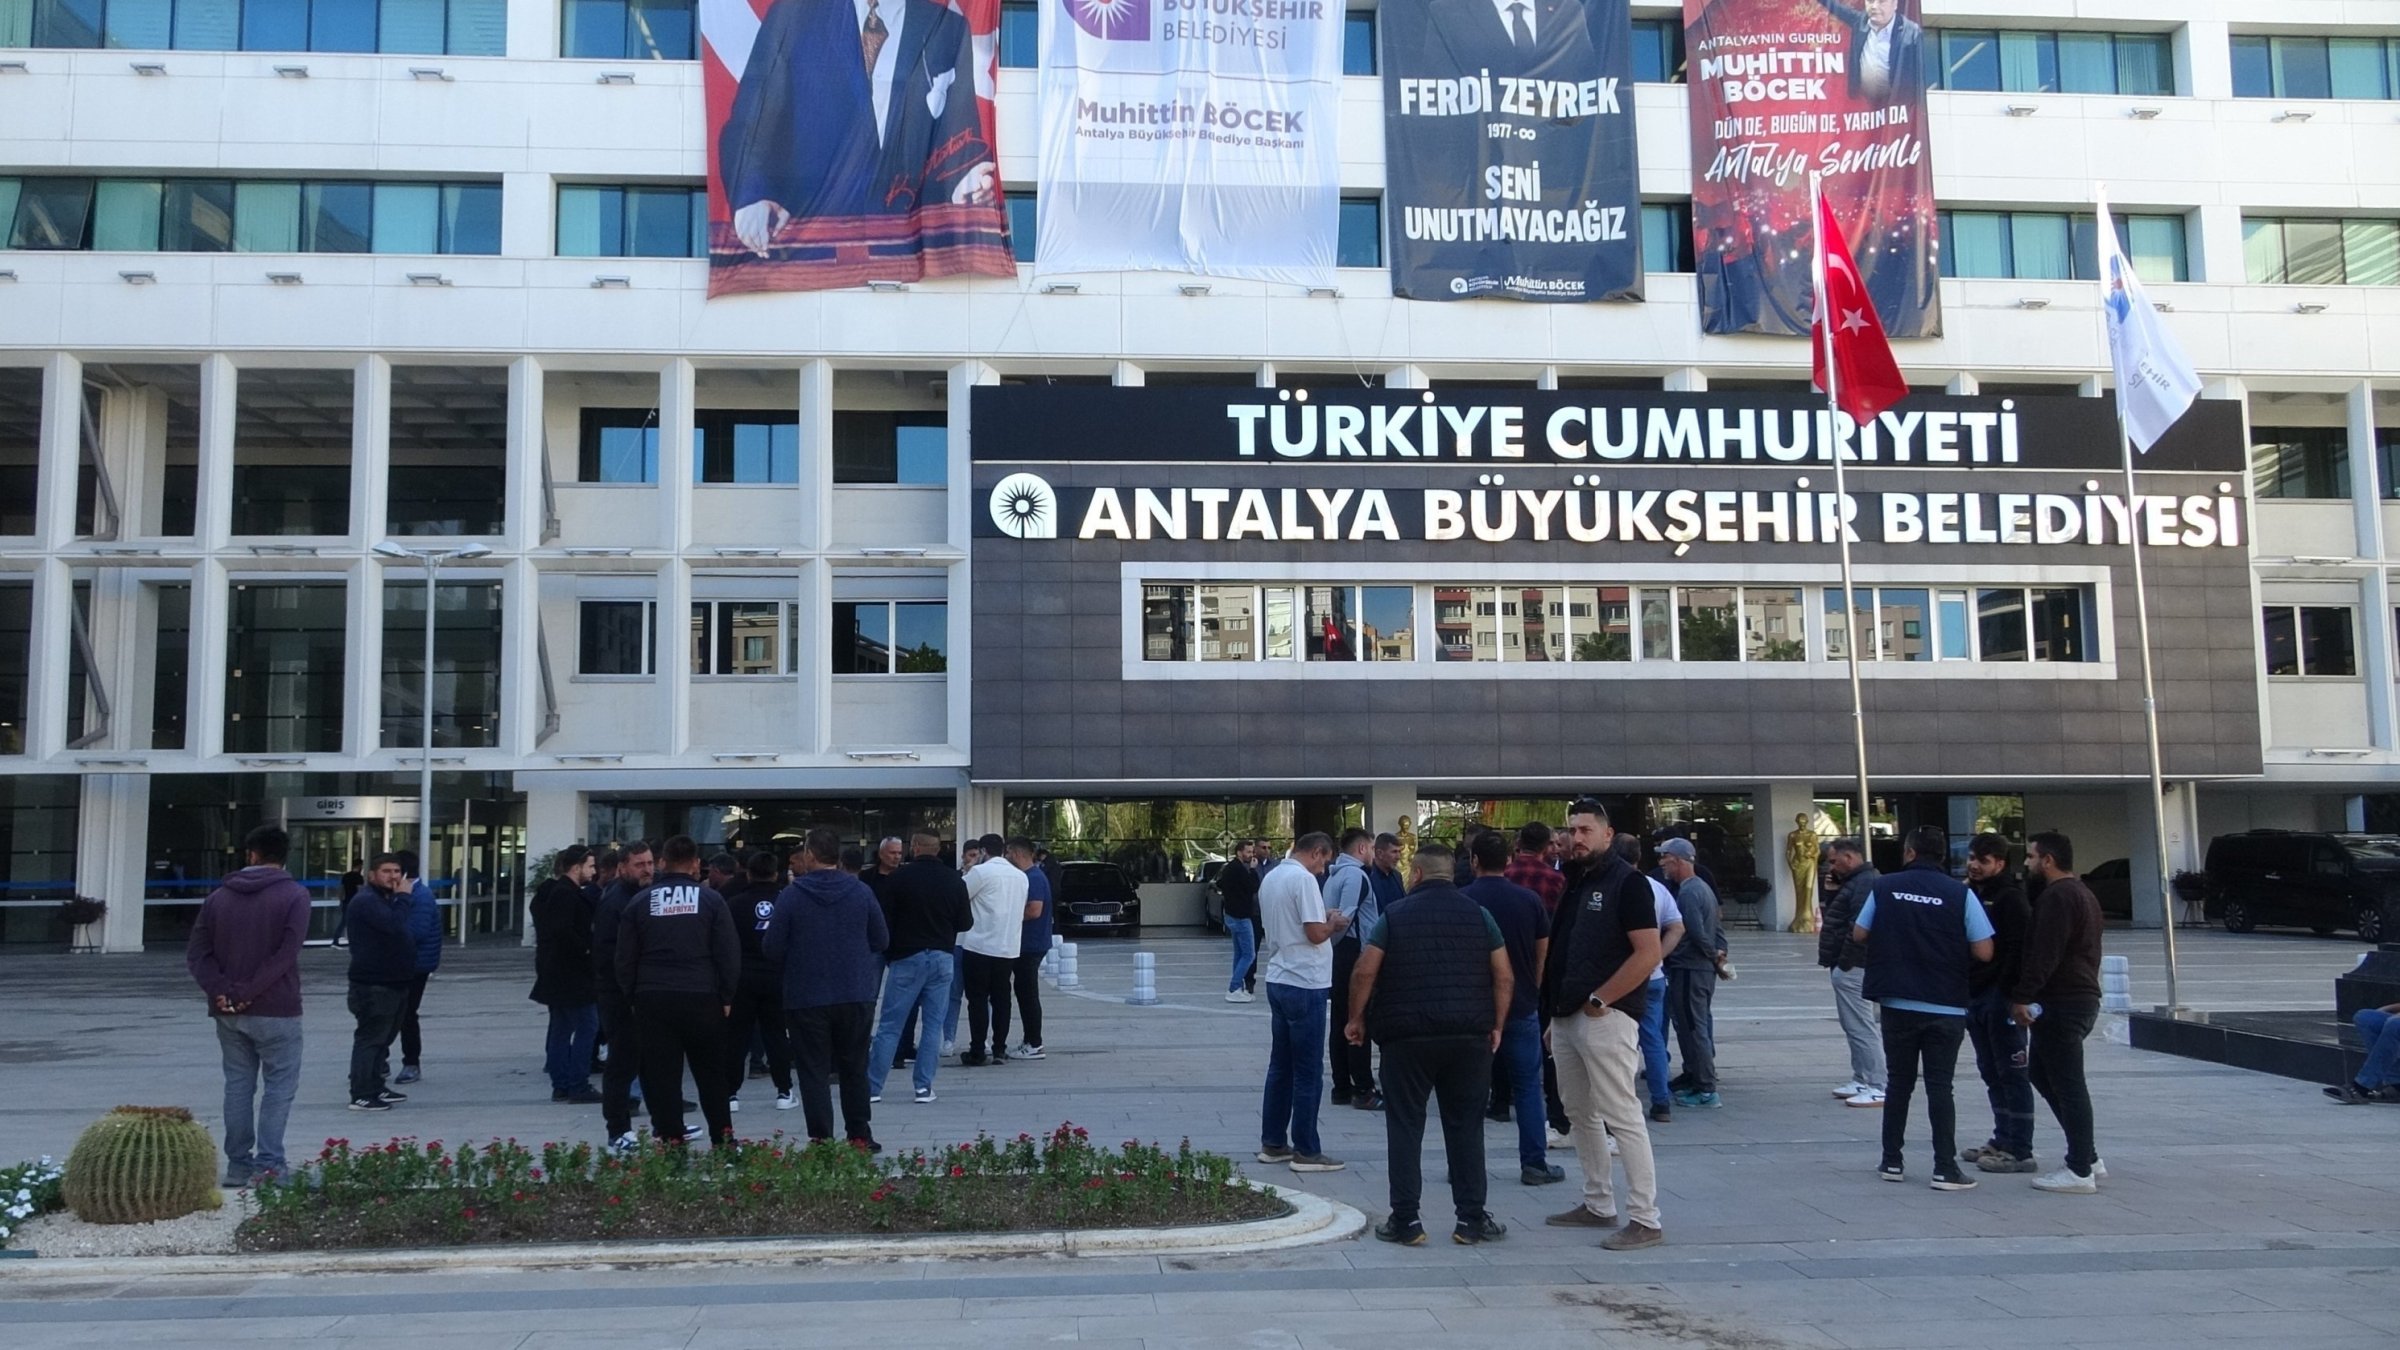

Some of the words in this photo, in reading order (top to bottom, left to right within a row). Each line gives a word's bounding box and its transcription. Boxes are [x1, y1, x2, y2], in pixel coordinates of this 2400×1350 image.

[1164, 20, 1287, 50] BELEDİYESİ
[1789, 32, 1842, 44] GURURU
[1700, 47, 1845, 81] MUHİTTİN
[1400, 68, 1493, 116] FERDİ
[1499, 76, 1621, 118] ZEYREK
[1723, 76, 1827, 103] BÖCEK
[1077, 97, 1194, 125] Muhittin
[1715, 115, 1743, 140] DÜN
[1771, 111, 1817, 134] BUGÜN
[1843, 108, 1886, 131] YARIN
[1889, 105, 1908, 124] DA
[1076, 126, 1125, 141] Antalya
[1255, 135, 1304, 149] Başkanı
[1487, 123, 1512, 138] 1977
[1704, 141, 1808, 187] Antalya
[1485, 160, 1541, 201] SENİ
[1405, 200, 1627, 243] UNUTMAYACAĞIZ
[1549, 279, 1585, 290] BÖCEK
[1227, 388, 1524, 458] TÜRKİYE
[1079, 487, 1400, 541] ANTALYA
[1425, 474, 1861, 556] BÜYÜKŞEHİR
[1884, 480, 2239, 548] BELEDİYESİ
[660, 886, 700, 905] CAN
[663, 904, 697, 914] HAFRİYAT
[1892, 891, 1943, 906] VOLVO
